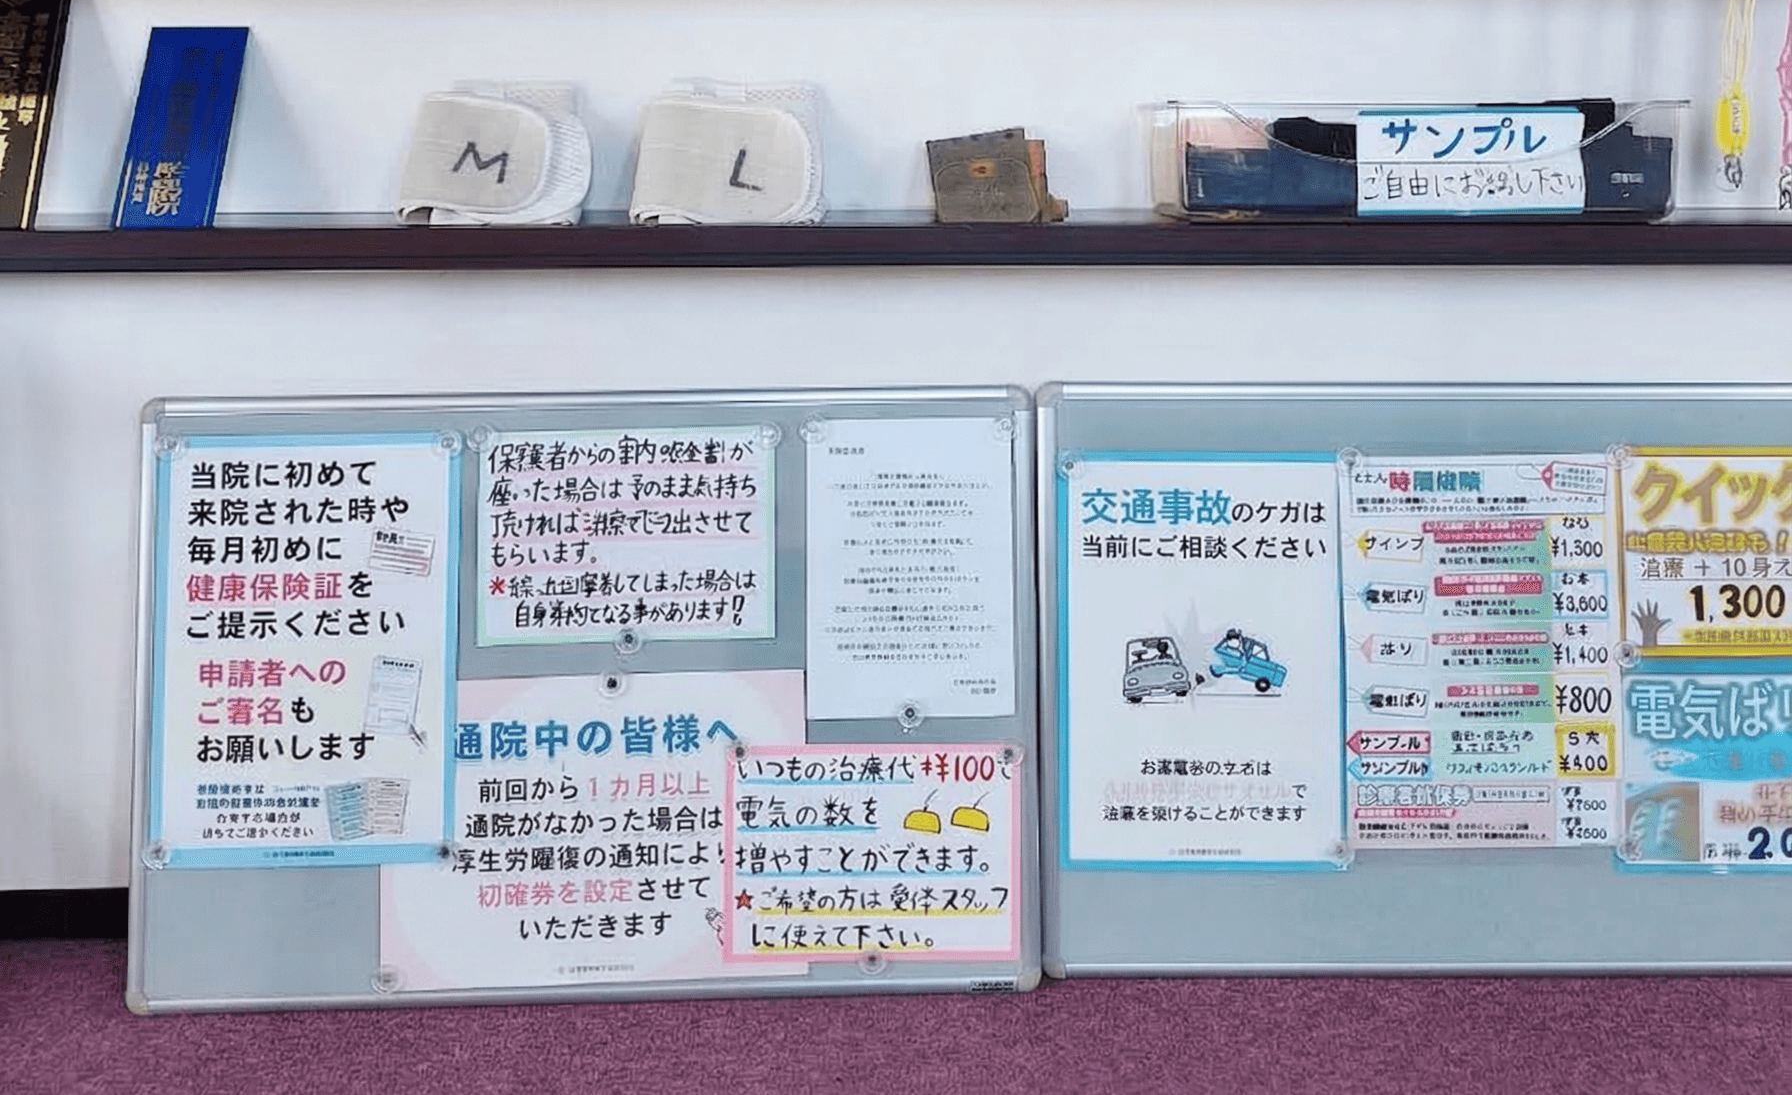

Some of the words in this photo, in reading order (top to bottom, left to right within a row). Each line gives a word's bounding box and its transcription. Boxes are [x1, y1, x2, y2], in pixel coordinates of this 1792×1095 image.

[1382, 117, 1547, 159] サンプル
[452, 141, 510, 184] M
[729, 148, 764, 191] L
[191, 460, 377, 490] 当院に初めて
[188, 496, 409, 526] 来院された時や
[1081, 487, 1327, 526] 交通事故のケガは
[187, 536, 342, 565] 毎月初めに
[491, 540, 597, 567] もらいます。
[186, 571, 373, 603] 健康保険証を
[1690, 584, 1786, 624] 1,300
[187, 609, 406, 640] ご提示ください
[199, 659, 346, 689] 申請者への
[1555, 685, 1612, 714] ¥800
[197, 732, 375, 763] お願いします
[454, 714, 737, 760] 通院中の皆様へ
[465, 806, 724, 839] 通院がなかった場合は
[736, 795, 878, 829] 電気の数を
[735, 843, 990, 874] 増やすことができます。
[519, 911, 673, 941] いただきます
